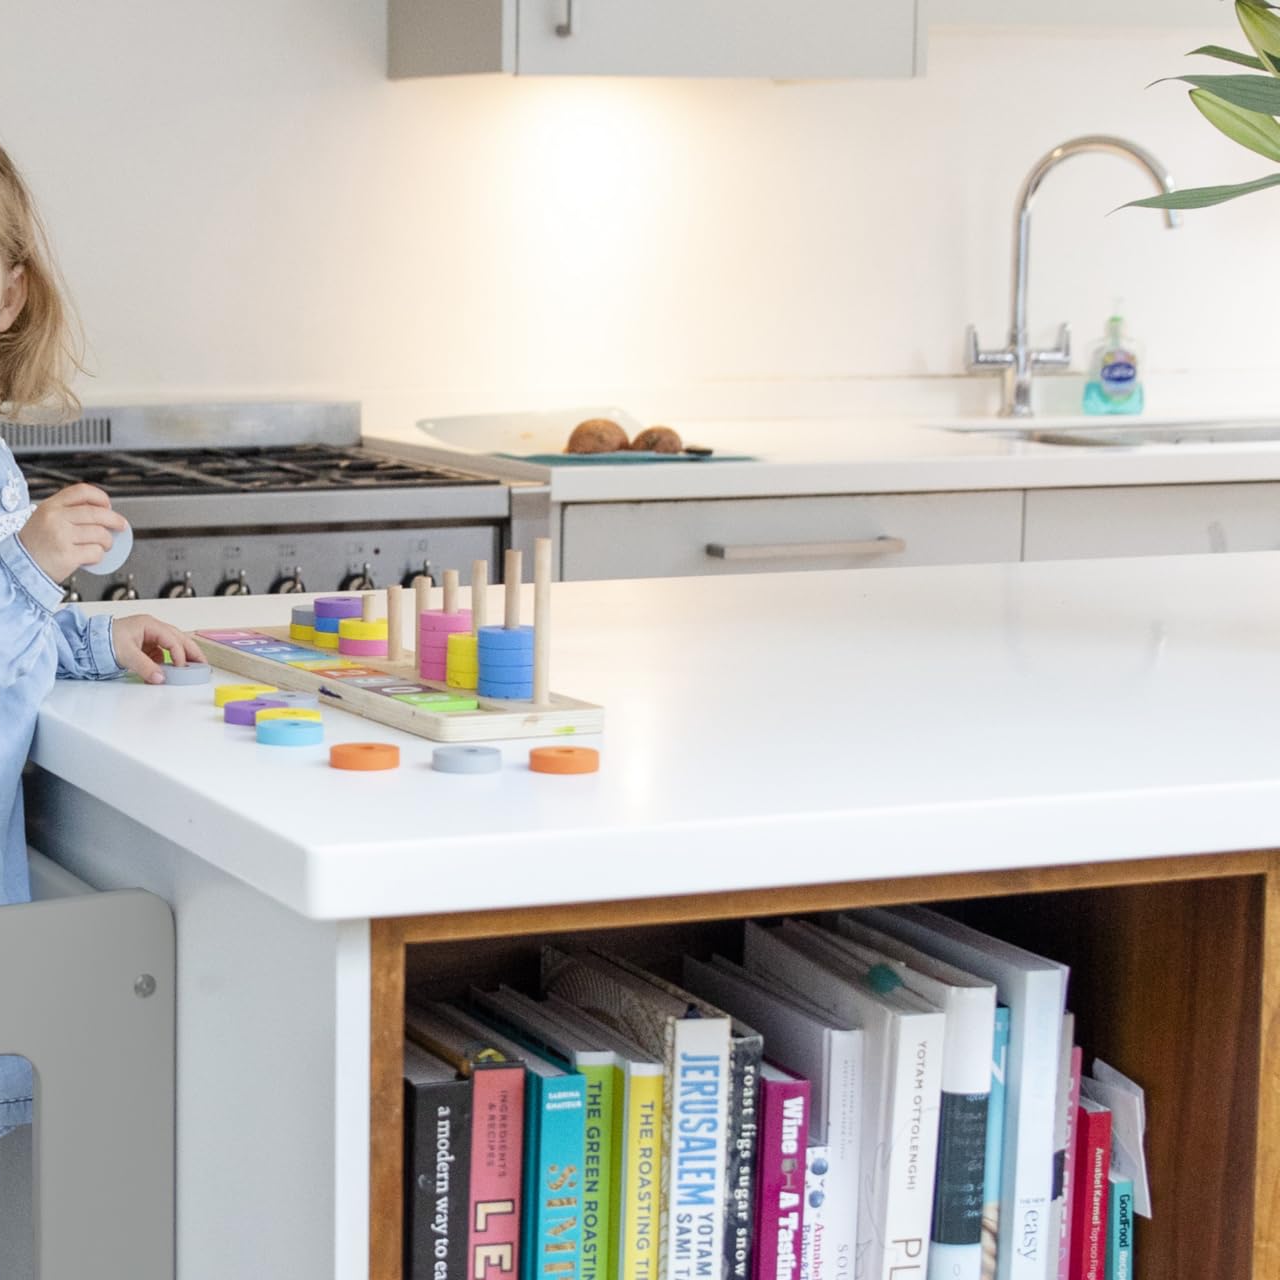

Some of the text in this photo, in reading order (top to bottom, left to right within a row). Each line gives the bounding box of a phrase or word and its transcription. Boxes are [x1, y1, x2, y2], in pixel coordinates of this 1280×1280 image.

[437, 1106, 451, 1117] a
[586, 1081, 602, 1118] THE
[742, 1065, 756, 1116] roast
[906, 1041, 927, 1191] YOTAM OTTOLENGHI
[486, 1114, 497, 1167] RECIPES
[498, 1090, 509, 1178] INGREDIENTS
[639, 1101, 655, 1140] THE
[676, 1053, 720, 1206] JERUSALEM
[736, 1123, 757, 1159] figs
[781, 1096, 804, 1154] Wine
[435, 1119, 455, 1193] modern
[585, 1126, 601, 1193] GREEN
[1093, 1147, 1104, 1193] Annabel
[431, 1197, 449, 1236] way
[636, 1146, 653, 1250] ROASTING
[734, 1165, 751, 1221] sugar
[779, 1191, 800, 1209] A
[1091, 1194, 1102, 1225] Karmel
[675, 1212, 692, 1260] SAMI
[696, 1212, 714, 1275] YOTAM
[1017, 1209, 1040, 1262] easy
[1089, 1226, 1100, 1243] Top
[1119, 1194, 1131, 1248] GoodFood
[434, 1239, 449, 1259] to
[734, 1228, 747, 1278] snow
